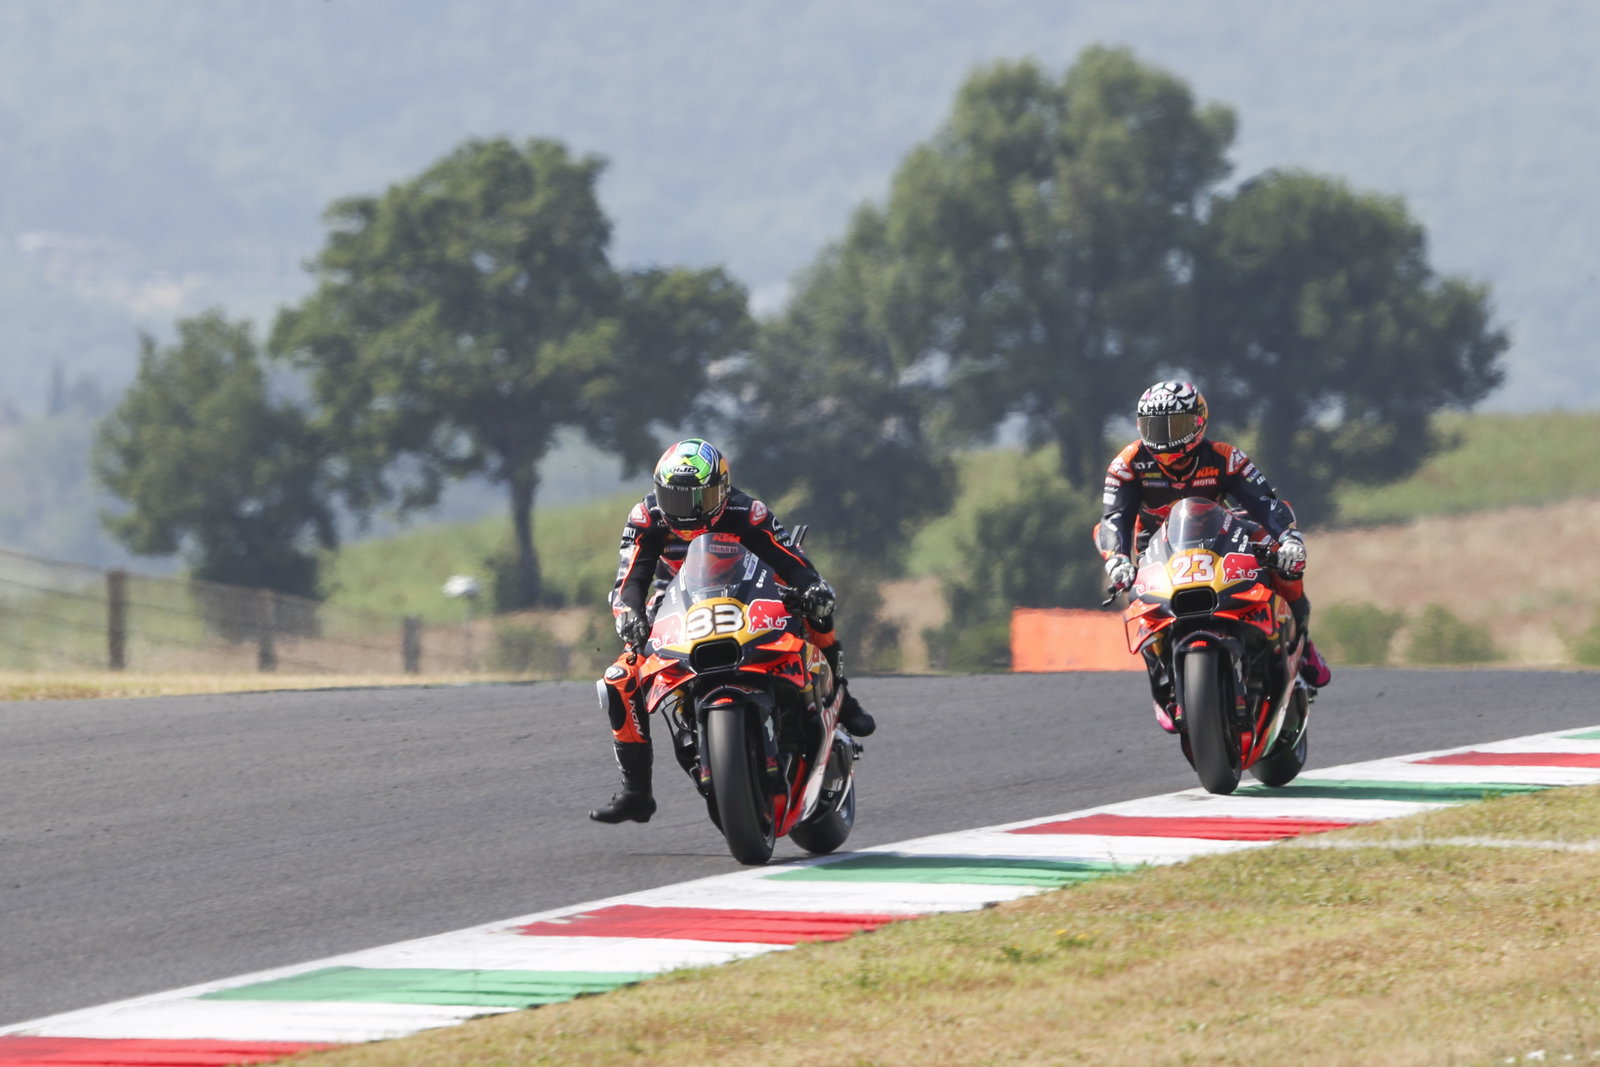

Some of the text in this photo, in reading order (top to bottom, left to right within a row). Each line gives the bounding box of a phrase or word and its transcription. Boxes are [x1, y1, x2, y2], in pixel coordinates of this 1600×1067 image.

[671, 466, 697, 474] HJC
[1196, 467, 1219, 478] KTM
[1192, 478, 1217, 487] MOTUL
[1171, 554, 1215, 585] 23
[1240, 608, 1269, 623] KTM
[764, 660, 802, 676] KTM
[628, 699, 645, 736] IXON
